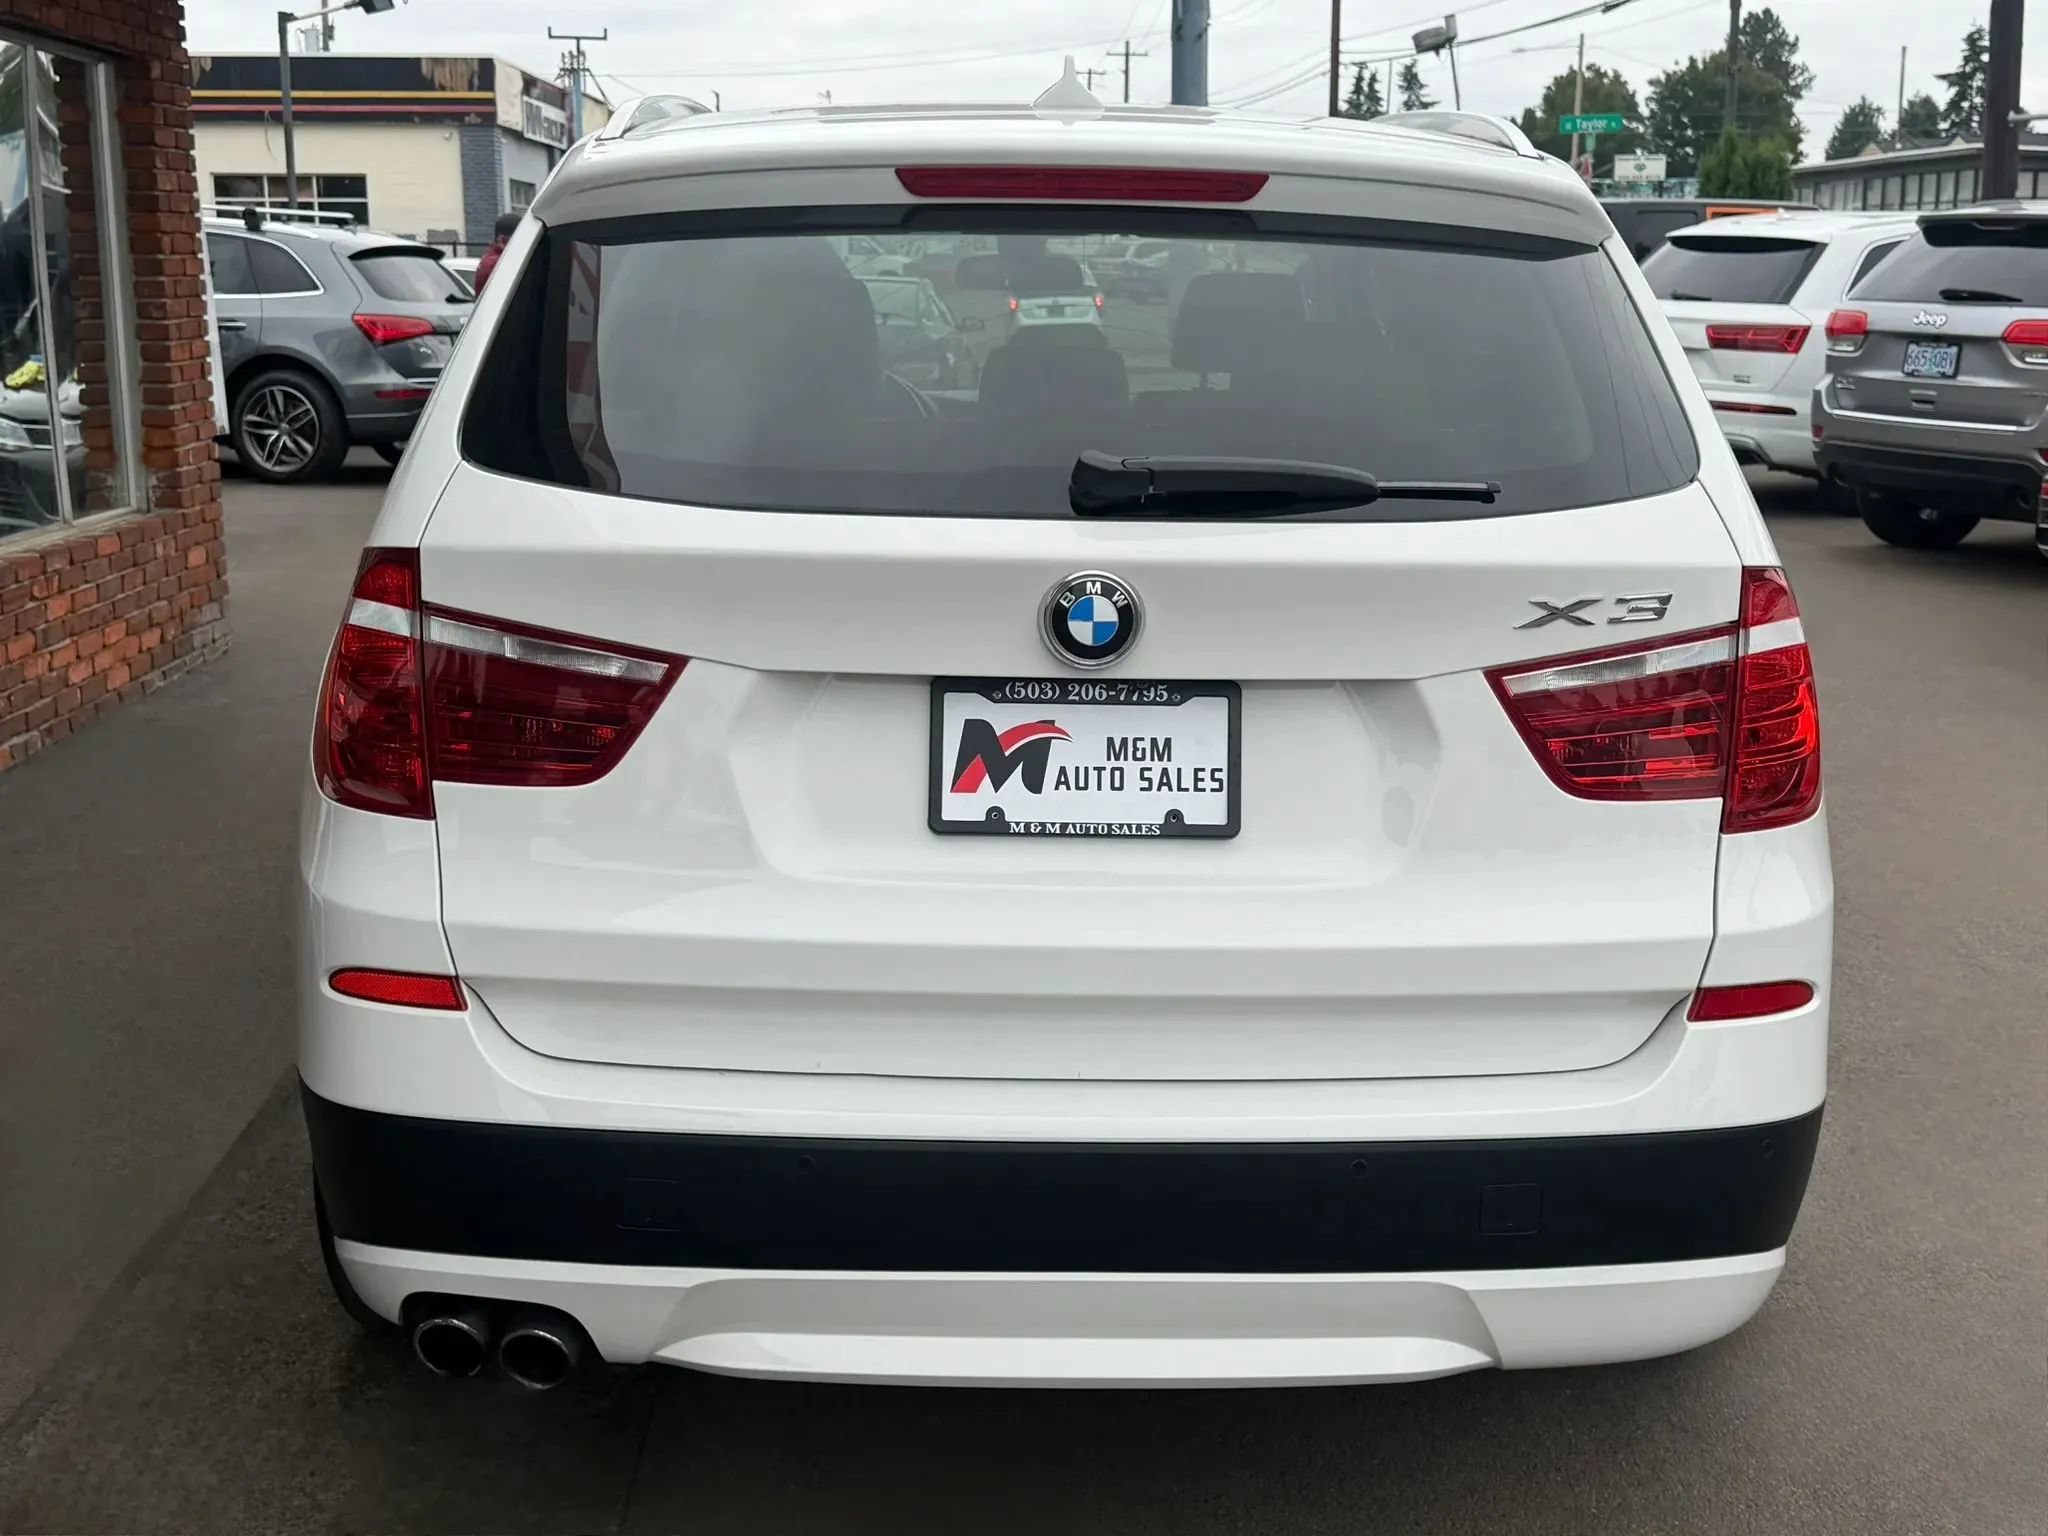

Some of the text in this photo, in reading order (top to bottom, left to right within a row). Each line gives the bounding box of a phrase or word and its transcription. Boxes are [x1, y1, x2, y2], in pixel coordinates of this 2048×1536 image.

[1575, 118, 1609, 131] Taylor
[1913, 309, 1947, 329] Jeep
[1059, 581, 1128, 609] BMW
[1512, 591, 1673, 630] X3
[1005, 681, 1061, 700] (503)
[1106, 736, 1173, 762] M&M
[1054, 765, 1225, 793] AUTO SALES
[1009, 822, 1161, 836] M & M AUTO SALES
